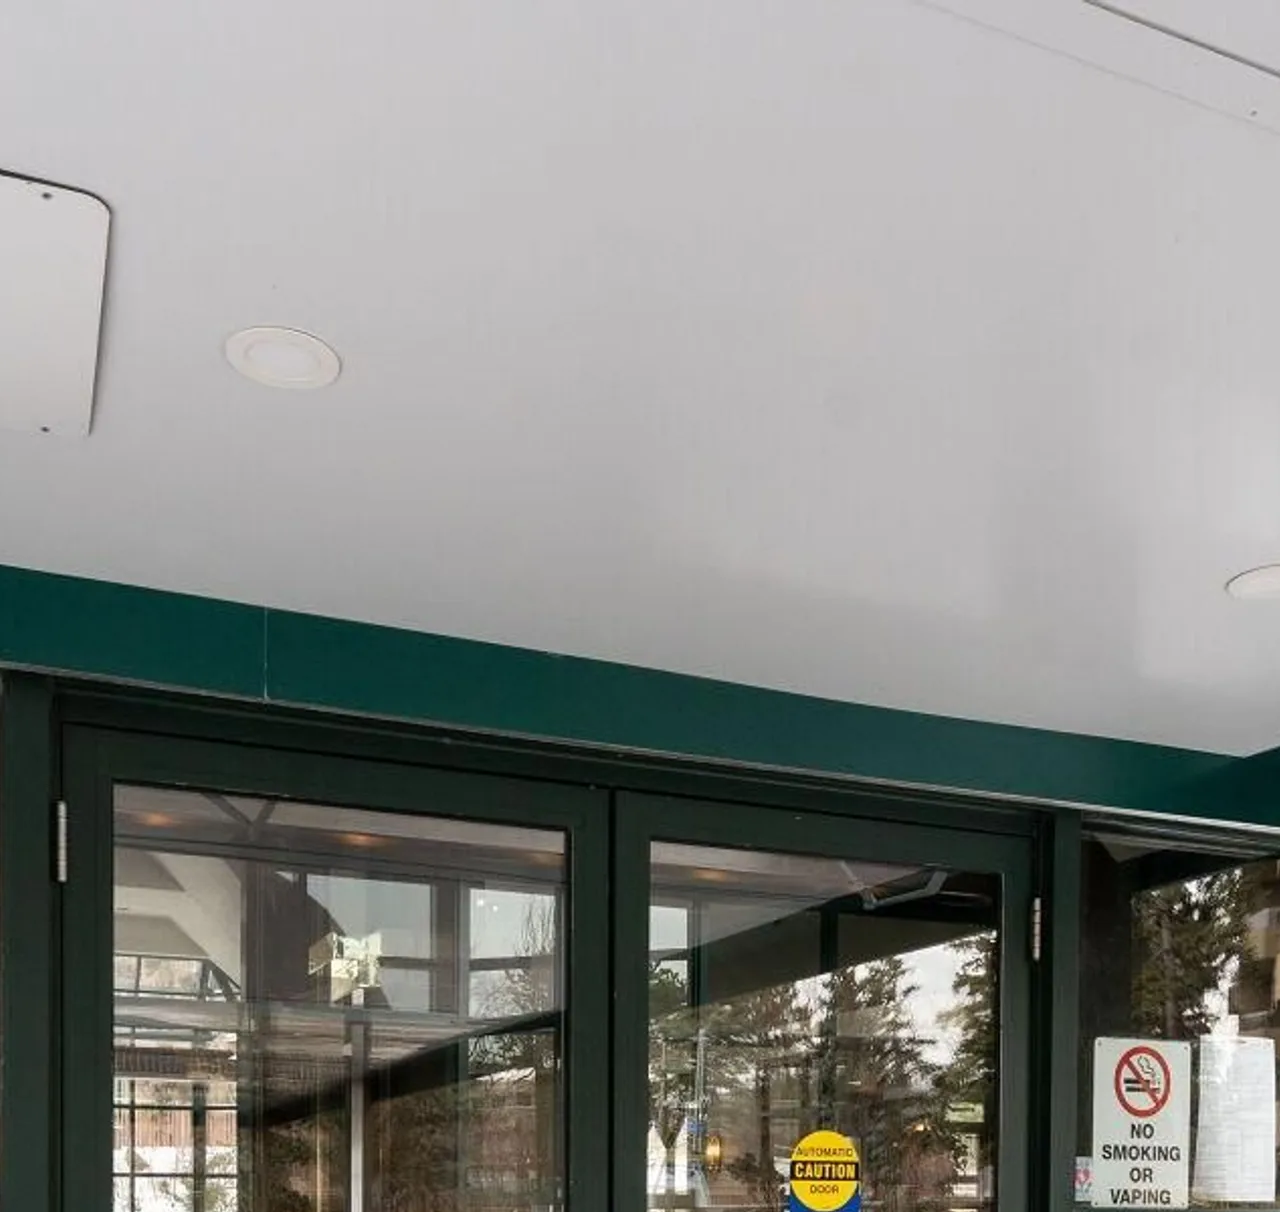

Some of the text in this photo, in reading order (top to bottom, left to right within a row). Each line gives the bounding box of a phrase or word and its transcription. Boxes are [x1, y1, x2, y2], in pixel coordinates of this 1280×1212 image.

[1130, 1123, 1155, 1139] NO
[795, 1147, 854, 1157] AUTOMATIC
[1101, 1144, 1181, 1162] SMOKING
[794, 1162, 856, 1179] CAUTION
[1129, 1167, 1153, 1183] OR
[809, 1184, 839, 1195] DOOR
[1110, 1188, 1172, 1205] VAPING
